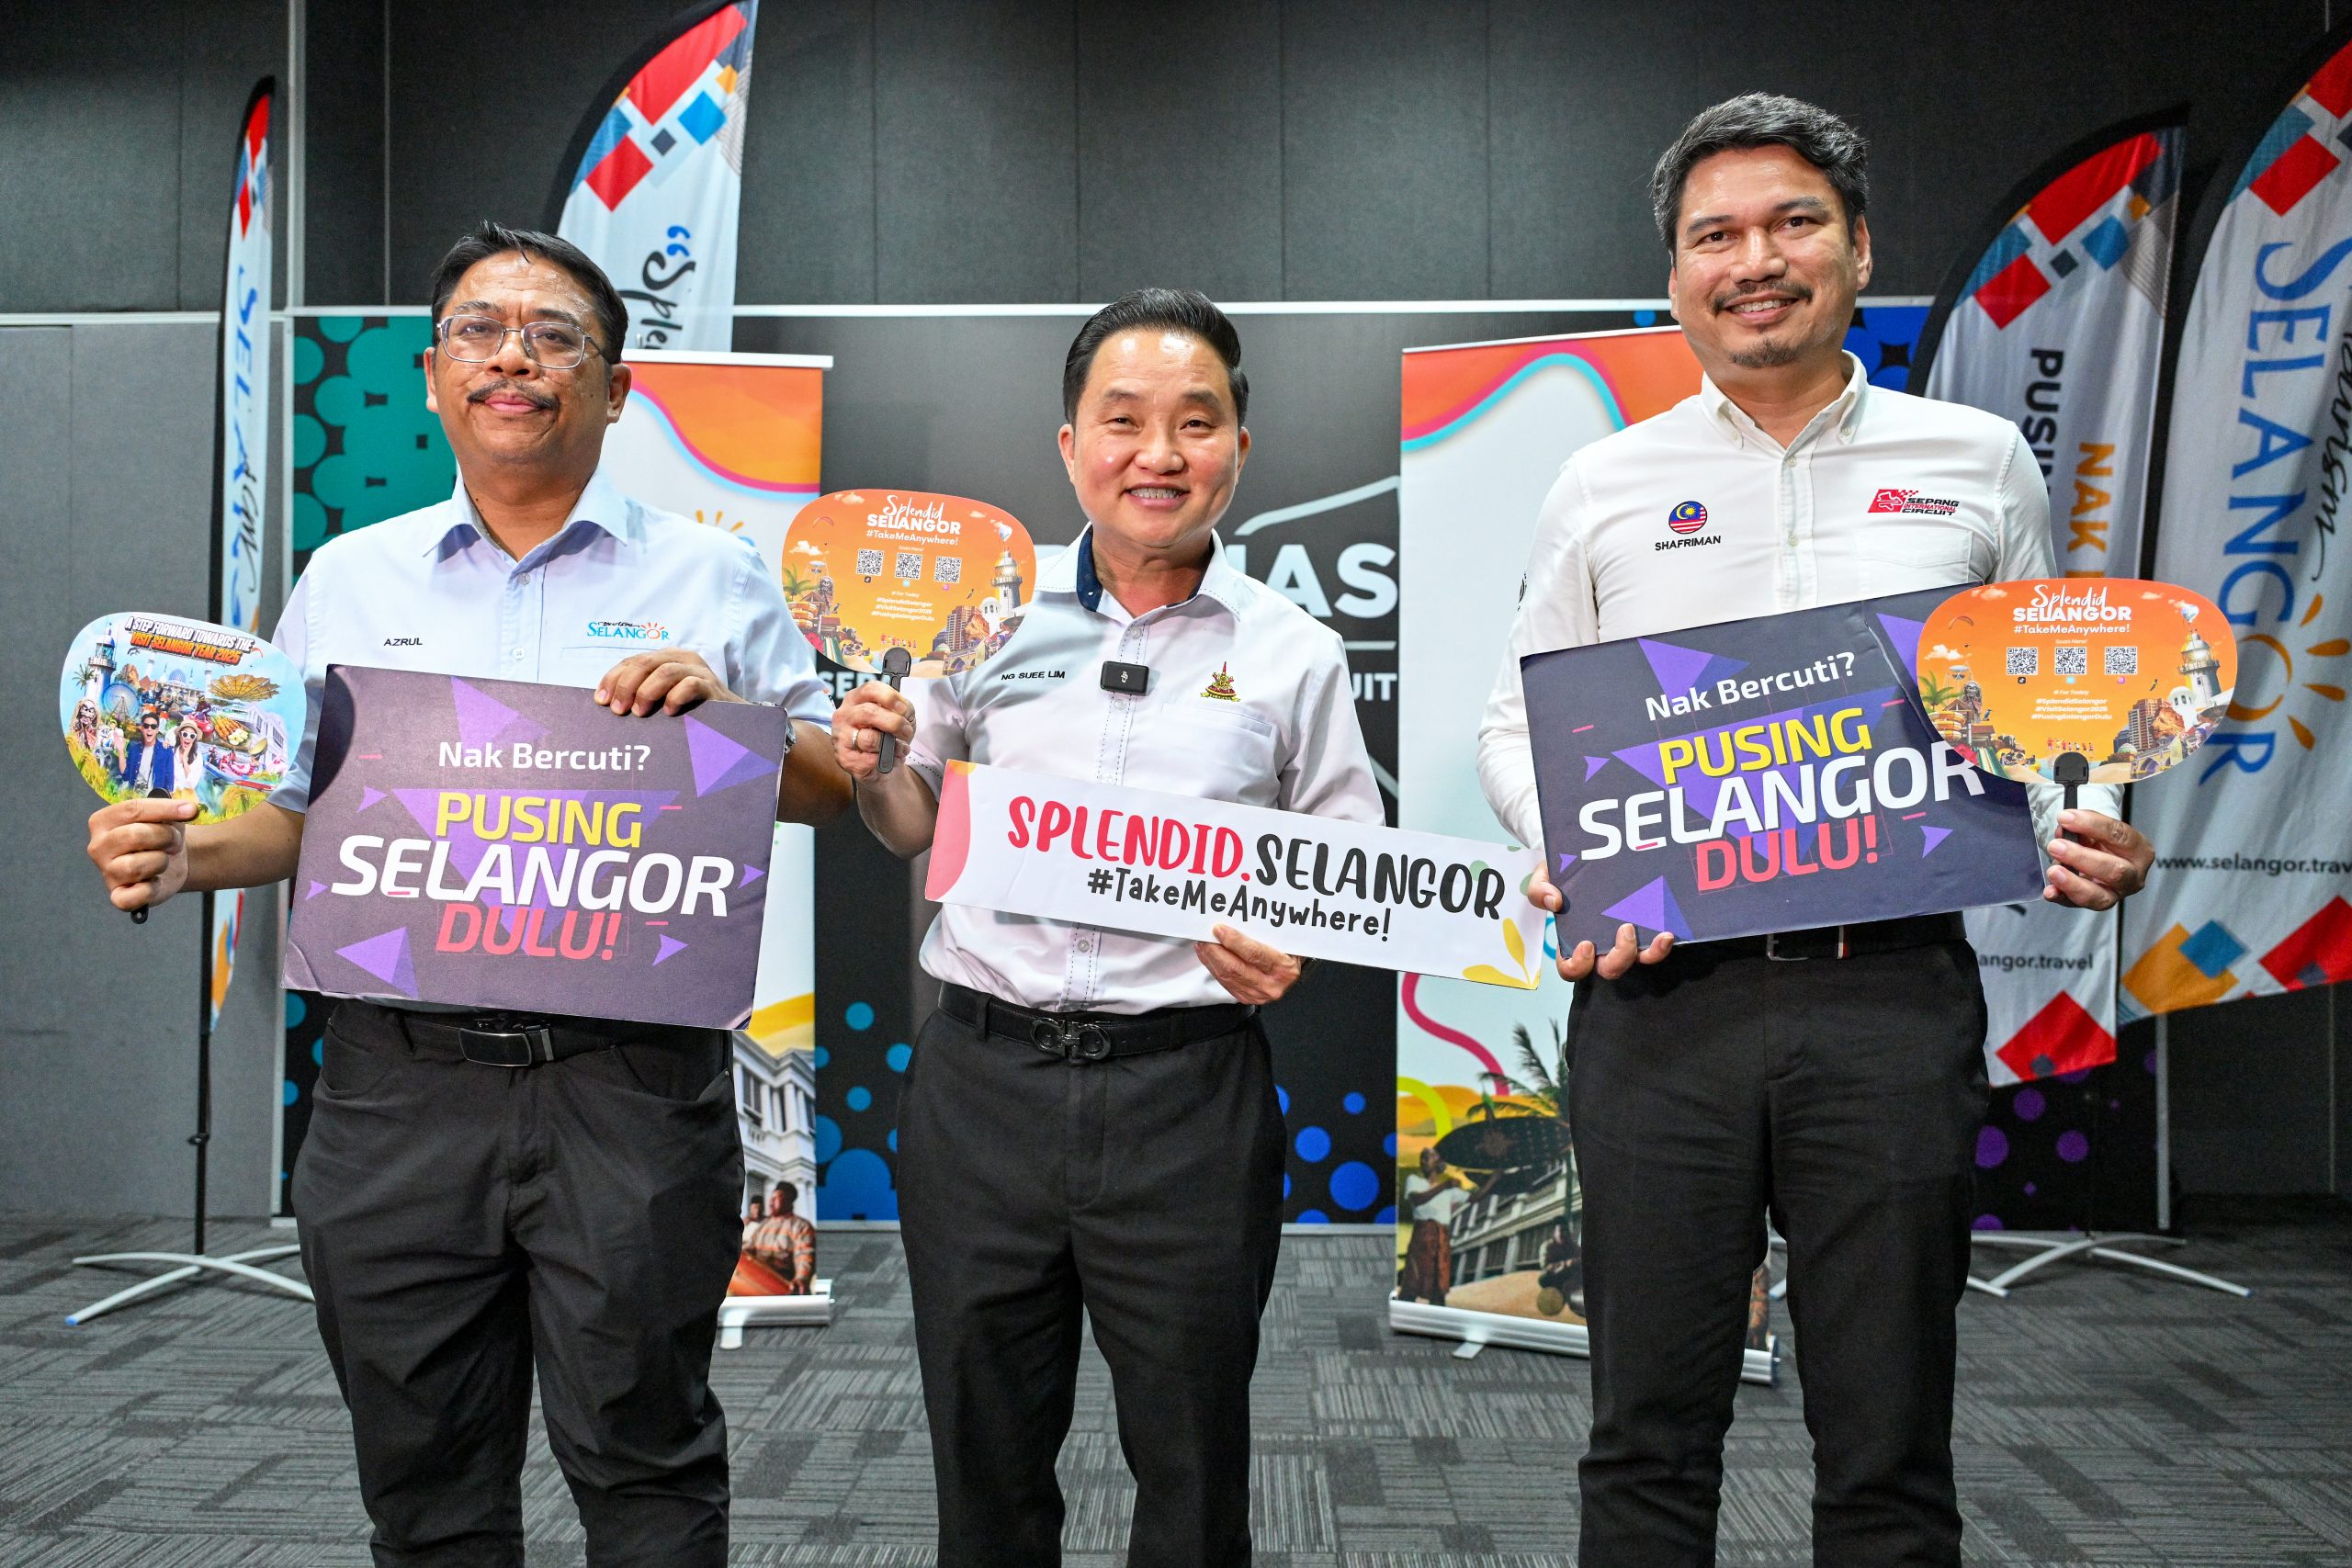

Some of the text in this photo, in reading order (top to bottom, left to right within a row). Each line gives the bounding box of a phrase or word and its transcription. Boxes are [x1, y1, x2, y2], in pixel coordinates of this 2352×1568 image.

[883, 494, 944, 524] Splendid
[1903, 503, 1956, 513] INTERNATIONAL
[1906, 497, 1960, 507] SEPANG
[2068, 442, 2115, 553] NAK
[2199, 238, 2352, 786] SELANGOR
[866, 513, 961, 535] SELANGOR
[866, 529, 958, 546] #TakeMeAnywhere!
[1655, 536, 1721, 551] SHAFRIMAN
[2030, 584, 2108, 610] Splendid
[2012, 606, 2132, 622] SELANGOR
[125, 616, 254, 653] A STEP FORWARD TOWARDS THE
[383, 637, 423, 647] AZRUL
[587, 621, 670, 641] SELANGOR
[2013, 623, 2131, 636] #TakeMeAnywhere!
[130, 631, 243, 665] VISIT SELANGOR YEAR 2025
[1047, 671, 1066, 679] LIM
[1645, 651, 1856, 721] Nak Bercuti?
[438, 741, 651, 771] Nak Bercuti?
[1657, 707, 1872, 784] PUSING
[1578, 741, 1985, 861] SELANGOR
[435, 792, 642, 848] PUSING
[1696, 814, 1878, 891] DULU!
[331, 834, 734, 917] SELANGOR
[1087, 866, 1390, 942] #TakeMeAnywhere!
[435, 903, 623, 961] DULU!
[1976, 953, 2094, 973] angor.travel
